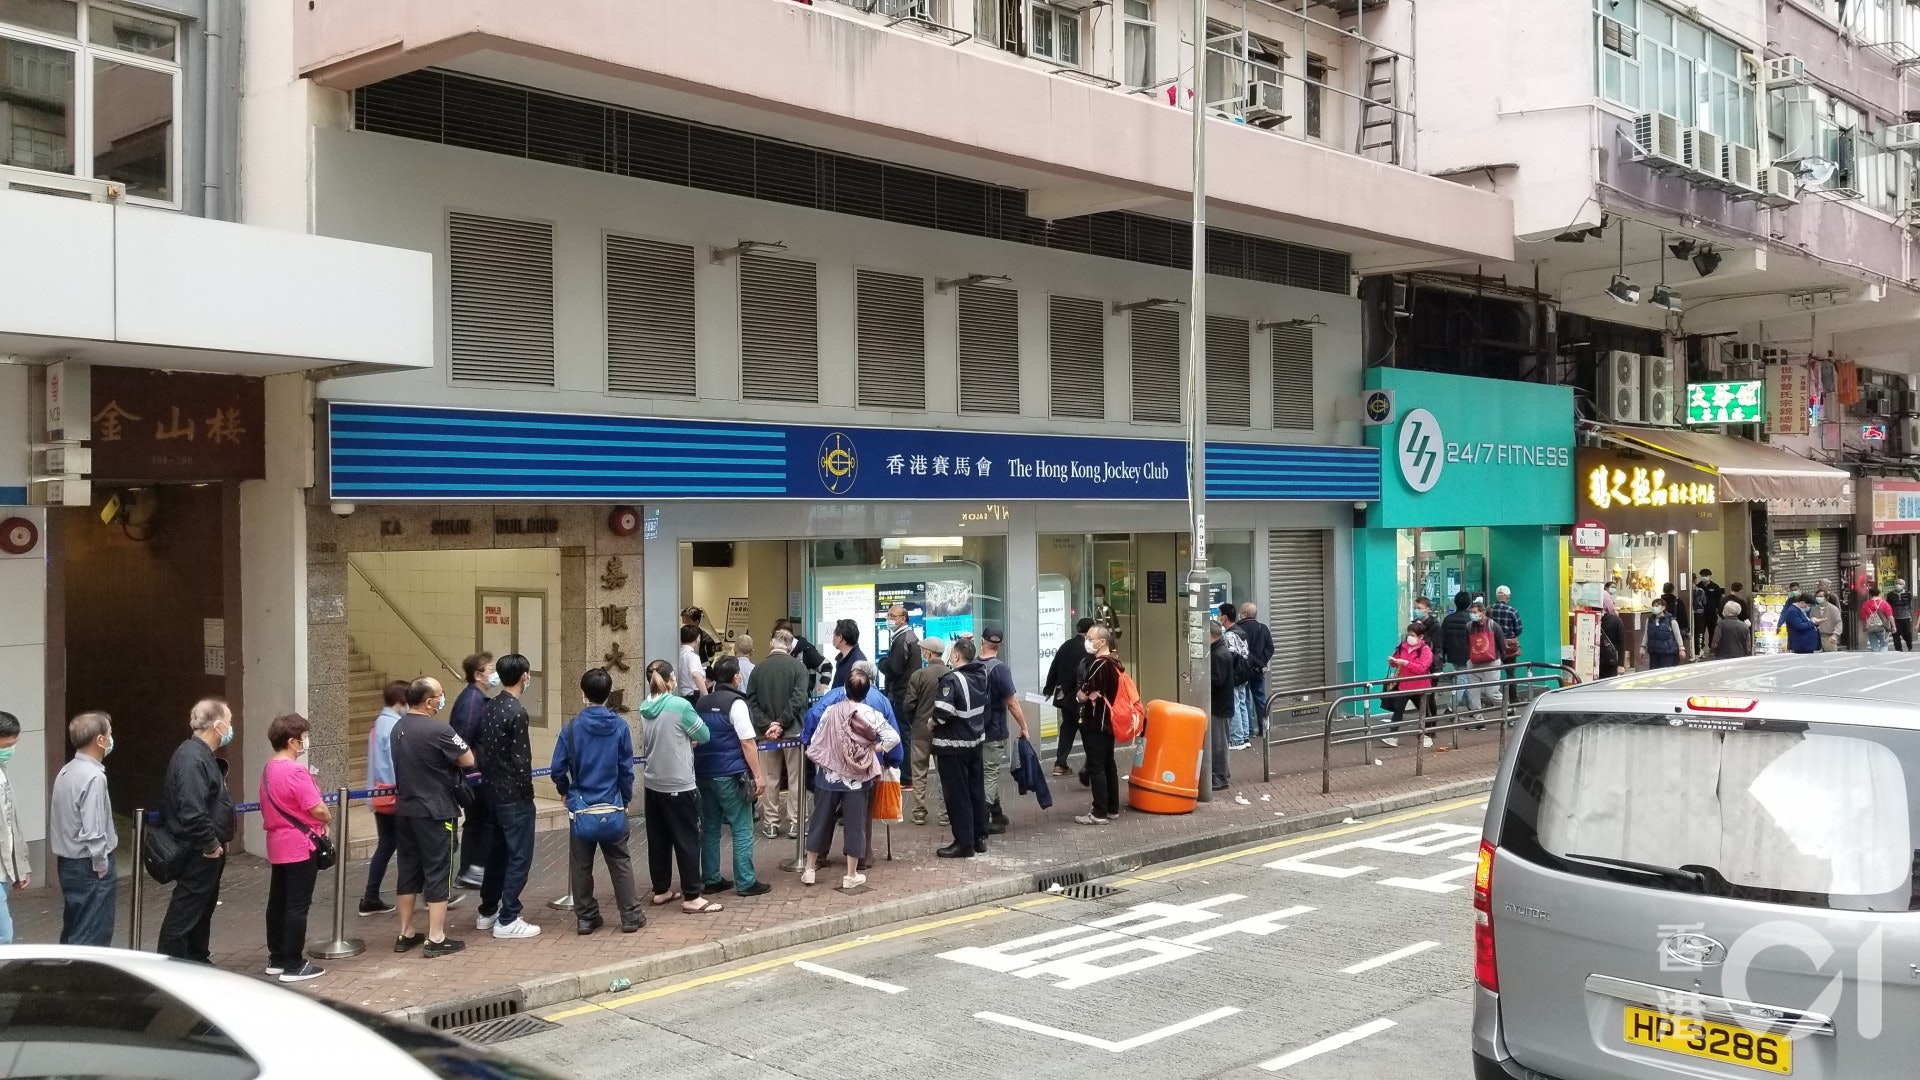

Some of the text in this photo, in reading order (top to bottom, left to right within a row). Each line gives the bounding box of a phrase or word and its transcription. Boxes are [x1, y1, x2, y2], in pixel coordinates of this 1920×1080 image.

[886, 454, 992, 477] 香港賽馬會
[1446, 442, 1569, 467] 24/7 FITNESS
[1008, 458, 1169, 484] The Hong Kong Jockey Club
[380, 518, 559, 535] KA SHUN BUILDING
[1634, 1013, 1778, 1065] HP 3286
